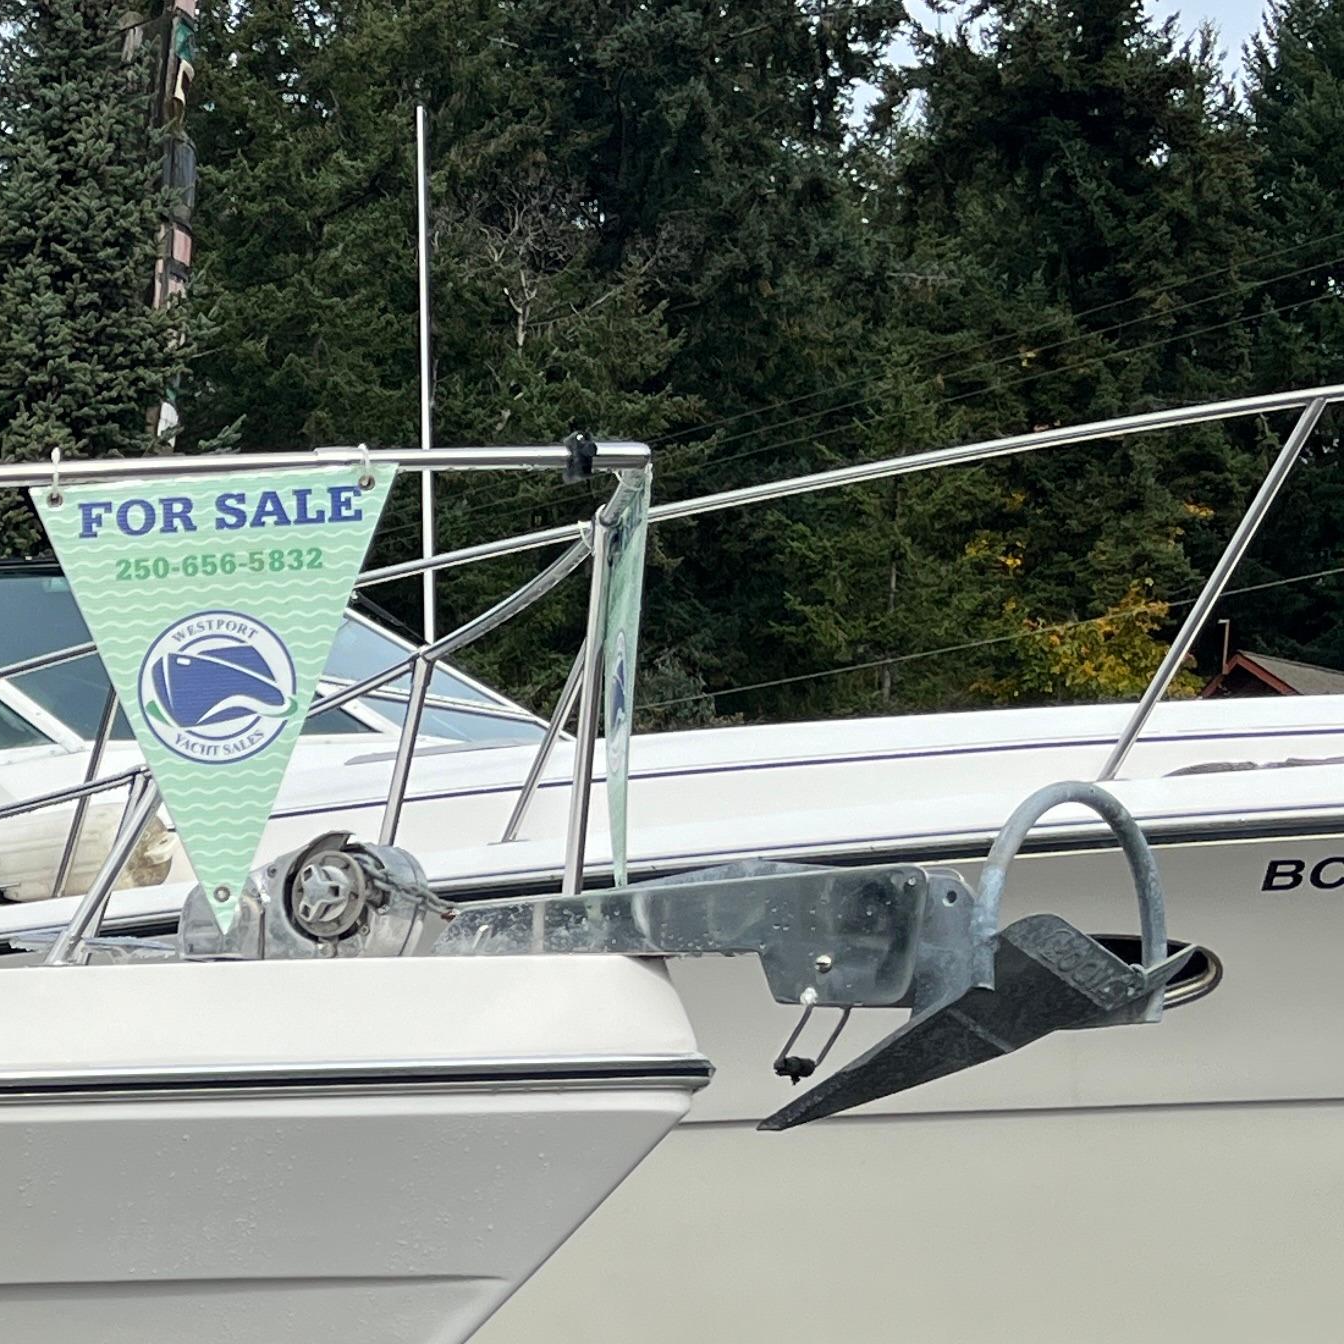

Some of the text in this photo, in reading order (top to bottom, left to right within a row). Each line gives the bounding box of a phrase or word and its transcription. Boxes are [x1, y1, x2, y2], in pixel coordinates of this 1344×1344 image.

[78, 486, 363, 538] FOR SALE
[115, 547, 323, 581] 250-656-5832
[171, 619, 259, 642] WESTPORT
[175, 729, 264, 756] YACHT SALES
[1261, 857, 1344, 891] BC
